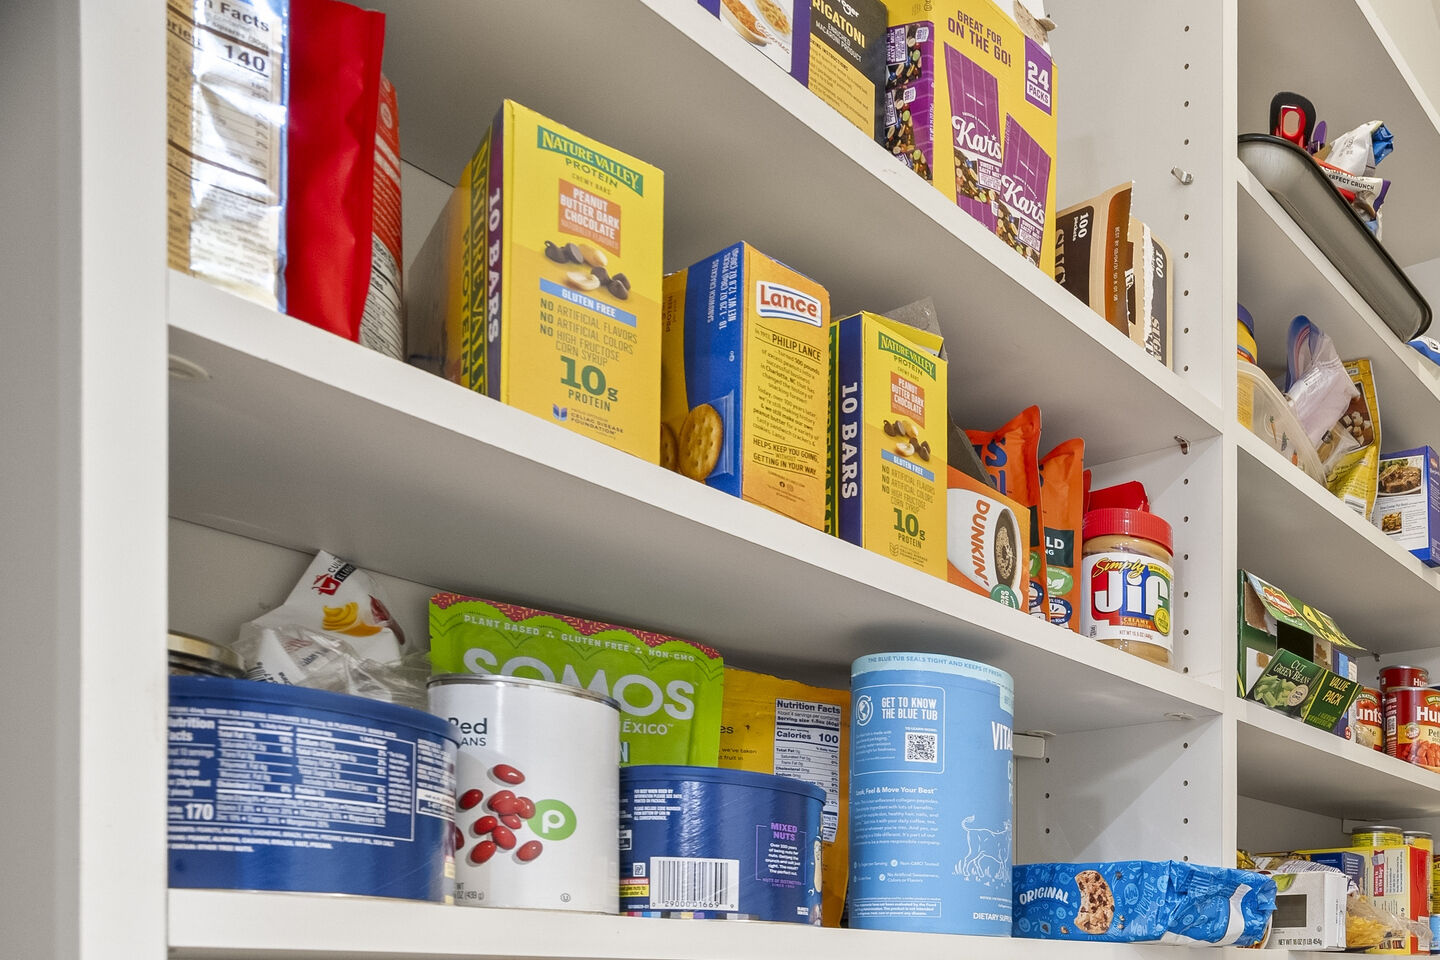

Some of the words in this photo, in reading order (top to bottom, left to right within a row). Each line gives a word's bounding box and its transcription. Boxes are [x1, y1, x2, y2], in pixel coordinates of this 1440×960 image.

[220, 2, 270, 32] Facts
[957, 10, 984, 34] GREAT
[986, 26, 1002, 47] FOR
[947, 17, 965, 39] ON
[969, 28, 989, 54] THE
[993, 42, 1012, 67] GO!
[224, 45, 266, 72] 140
[1027, 60, 1050, 91] 24
[1028, 83, 1049, 104] PACKS
[541, 128, 595, 164] NATURE
[595, 153, 641, 191] VALLEY
[565, 158, 619, 188] PROTEIN
[1350, 180, 1375, 190] CRUNCH
[489, 188, 500, 232] 10
[573, 187, 609, 211] PEANUT
[560, 194, 595, 218] BUTTER
[596, 211, 620, 230] DARK
[564, 209, 615, 239] CHOCOLATE
[488, 240, 500, 343] BARS
[561, 289, 594, 310] GLUTEN
[596, 302, 616, 318] FREE
[760, 284, 817, 318] Lance
[557, 305, 600, 329] ARTIFICIAL
[557, 317, 600, 341] ARTIFICIAL
[772, 333, 798, 351] PHILIP
[798, 342, 821, 361] LANCE
[881, 335, 911, 361] NATURE
[911, 351, 935, 375] VALLEY
[893, 355, 923, 376] PROTEIN
[568, 389, 611, 411] PROTEIN
[841, 381, 858, 413] 10
[841, 421, 858, 498] BARS
[1092, 557, 1146, 579] Simply
[463, 614, 500, 628] PLANT
[503, 623, 540, 636] BASED
[561, 633, 601, 648] GLUTEN
[604, 642, 630, 653] FREE
[648, 649, 695, 662] NON-GMO
[927, 657, 947, 665] TIGHT
[964, 663, 982, 672] KEEPS
[1273, 663, 1293, 678] GREEN
[1290, 659, 1308, 673] CUT
[1328, 676, 1351, 692] VALUE
[776, 700, 815, 712] Nutrition
[818, 702, 841, 715] Facts
[881, 697, 895, 708] GET
[898, 696, 909, 708] TO
[911, 697, 937, 708] KNOW
[1321, 689, 1344, 707] PACK
[881, 708, 896, 719] THE
[897, 708, 918, 720] BLUE
[921, 709, 938, 721] TUB
[776, 731, 811, 740] Calories
[818, 732, 839, 743] 100
[918, 786, 934, 794] Best
[185, 803, 214, 821] 170
[770, 822, 798, 833] MIXED
[773, 831, 796, 841] NUTS
[1019, 886, 1069, 905] ORIGINAL
